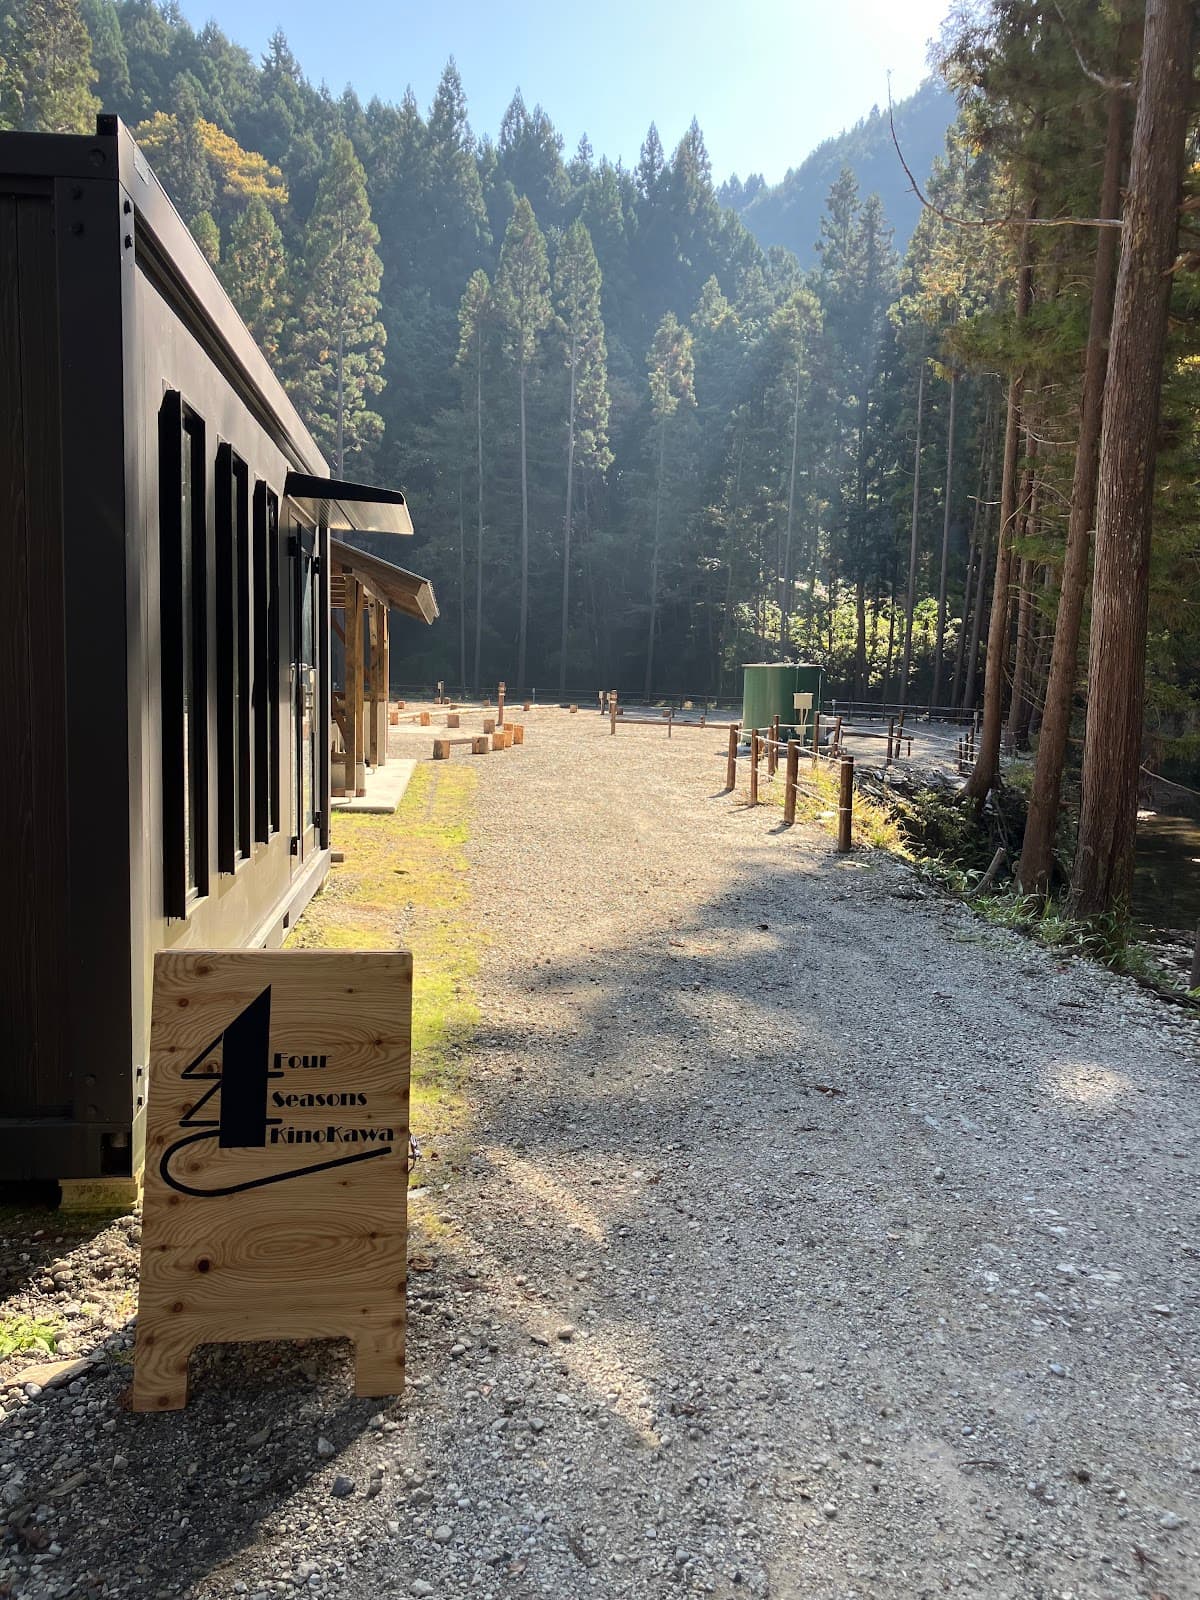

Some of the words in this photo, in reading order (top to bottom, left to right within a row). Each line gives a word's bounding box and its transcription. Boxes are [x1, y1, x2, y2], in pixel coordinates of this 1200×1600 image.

[273, 1052, 332, 1069] Four
[272, 1091, 367, 1107] Seasons
[270, 1126, 394, 1144] KinoKawa
